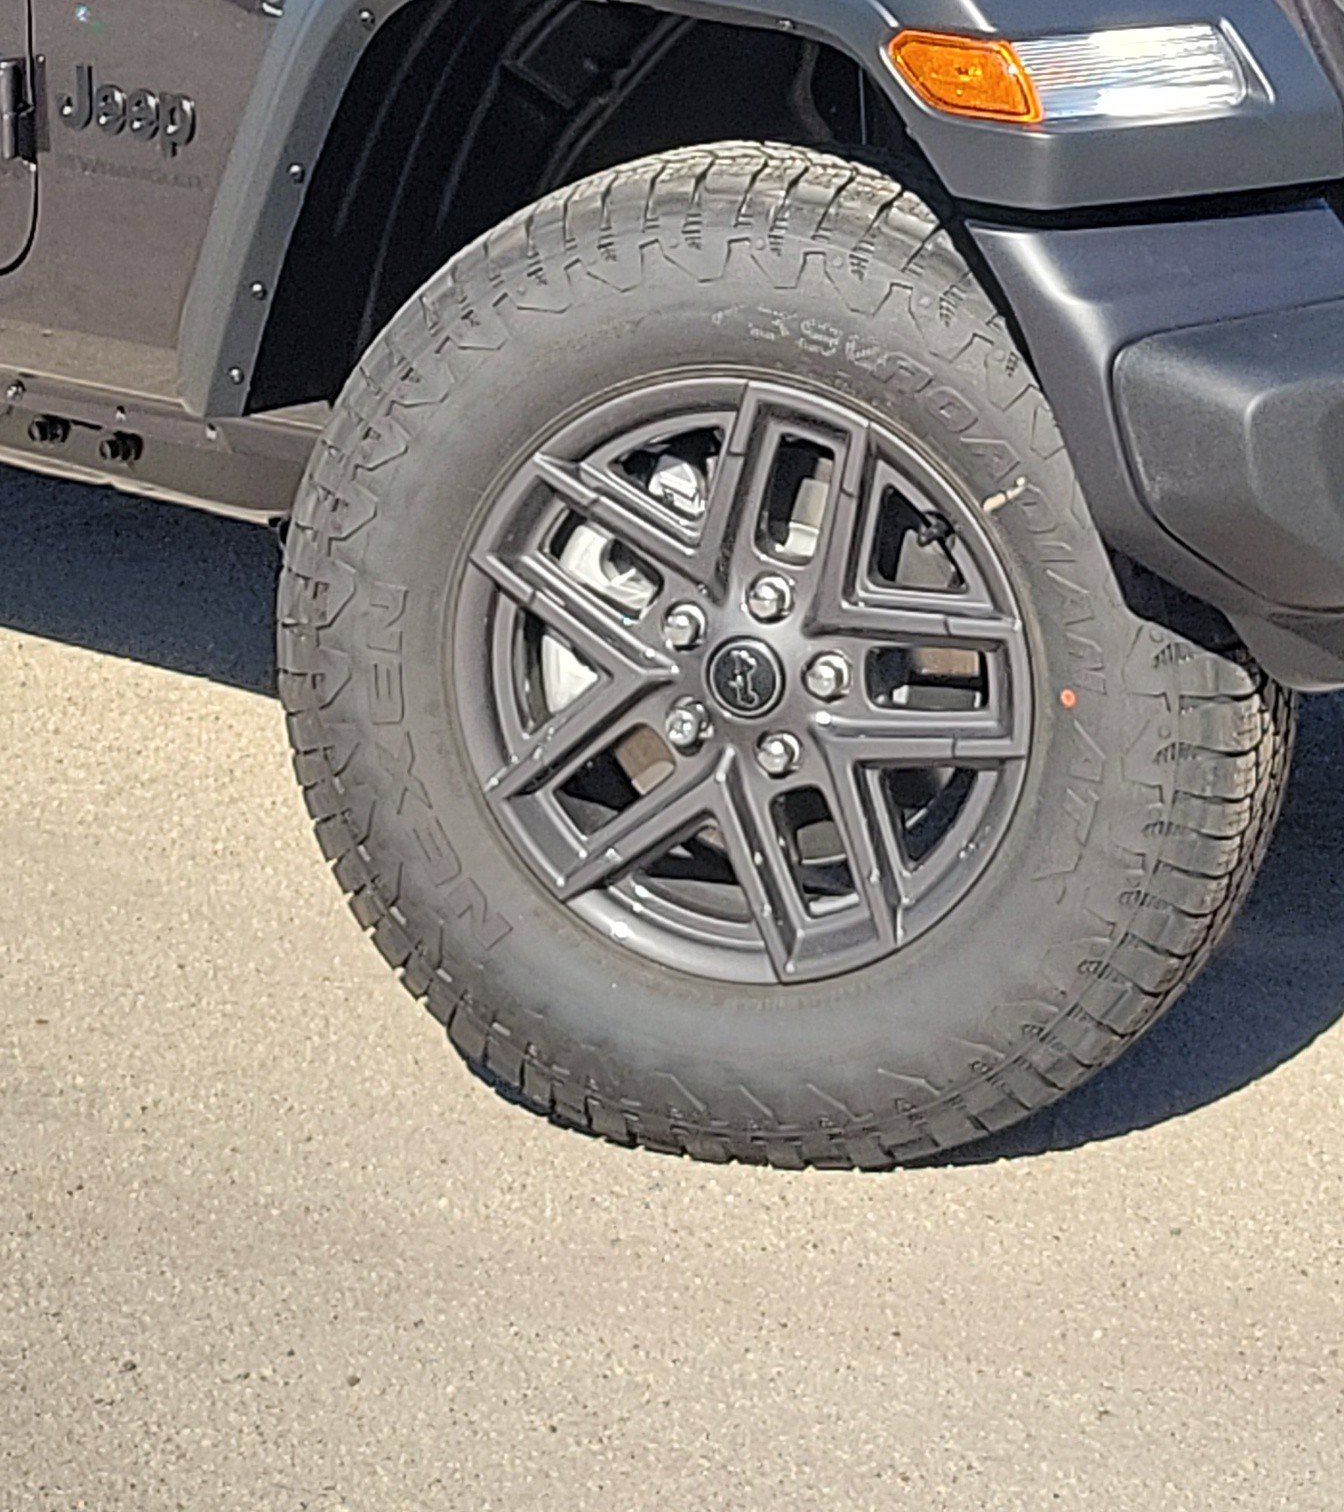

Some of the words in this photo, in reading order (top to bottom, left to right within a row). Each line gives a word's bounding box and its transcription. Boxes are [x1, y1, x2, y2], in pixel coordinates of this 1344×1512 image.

[58, 64, 196, 158] Jeep
[868, 350, 1108, 695] ROADIAN
[363, 579, 514, 952] NEXEN
